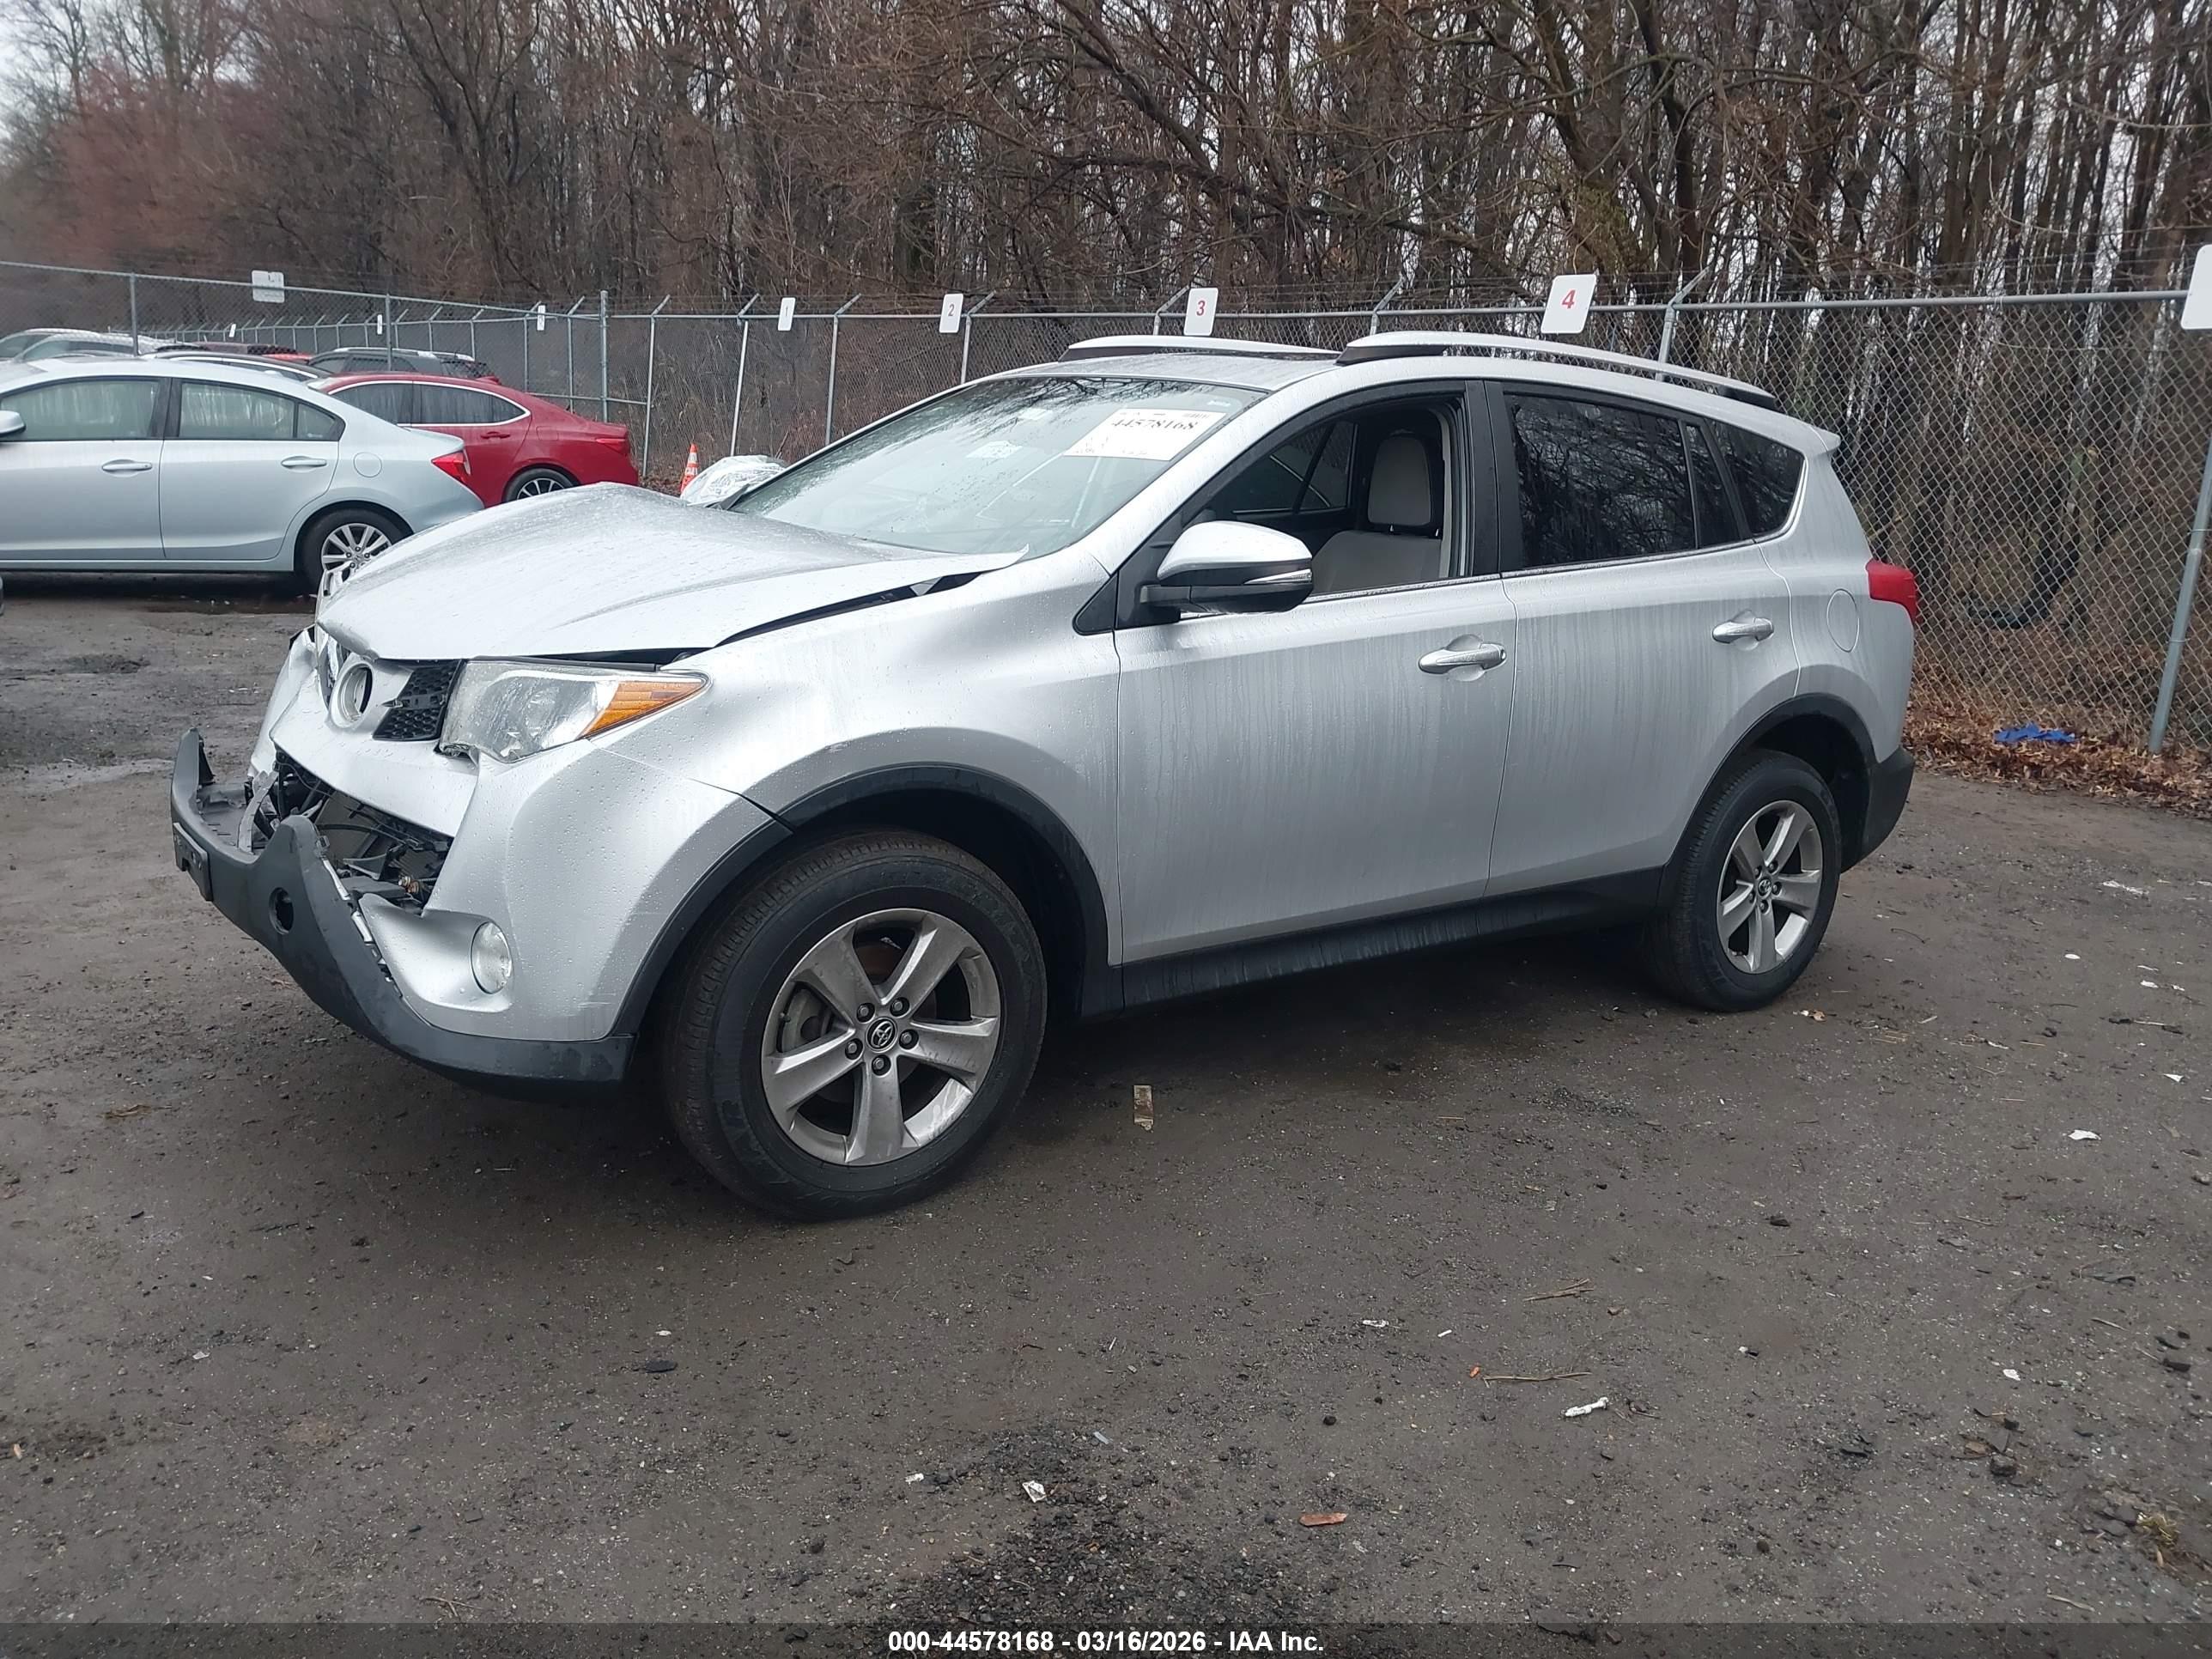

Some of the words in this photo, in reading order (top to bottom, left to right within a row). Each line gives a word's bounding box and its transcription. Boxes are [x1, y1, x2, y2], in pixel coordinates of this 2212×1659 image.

[1561, 289, 1576, 309] 4
[948, 303, 955, 317] 2
[1196, 300, 1206, 316] 3
[1111, 418, 1200, 430] 44578168
